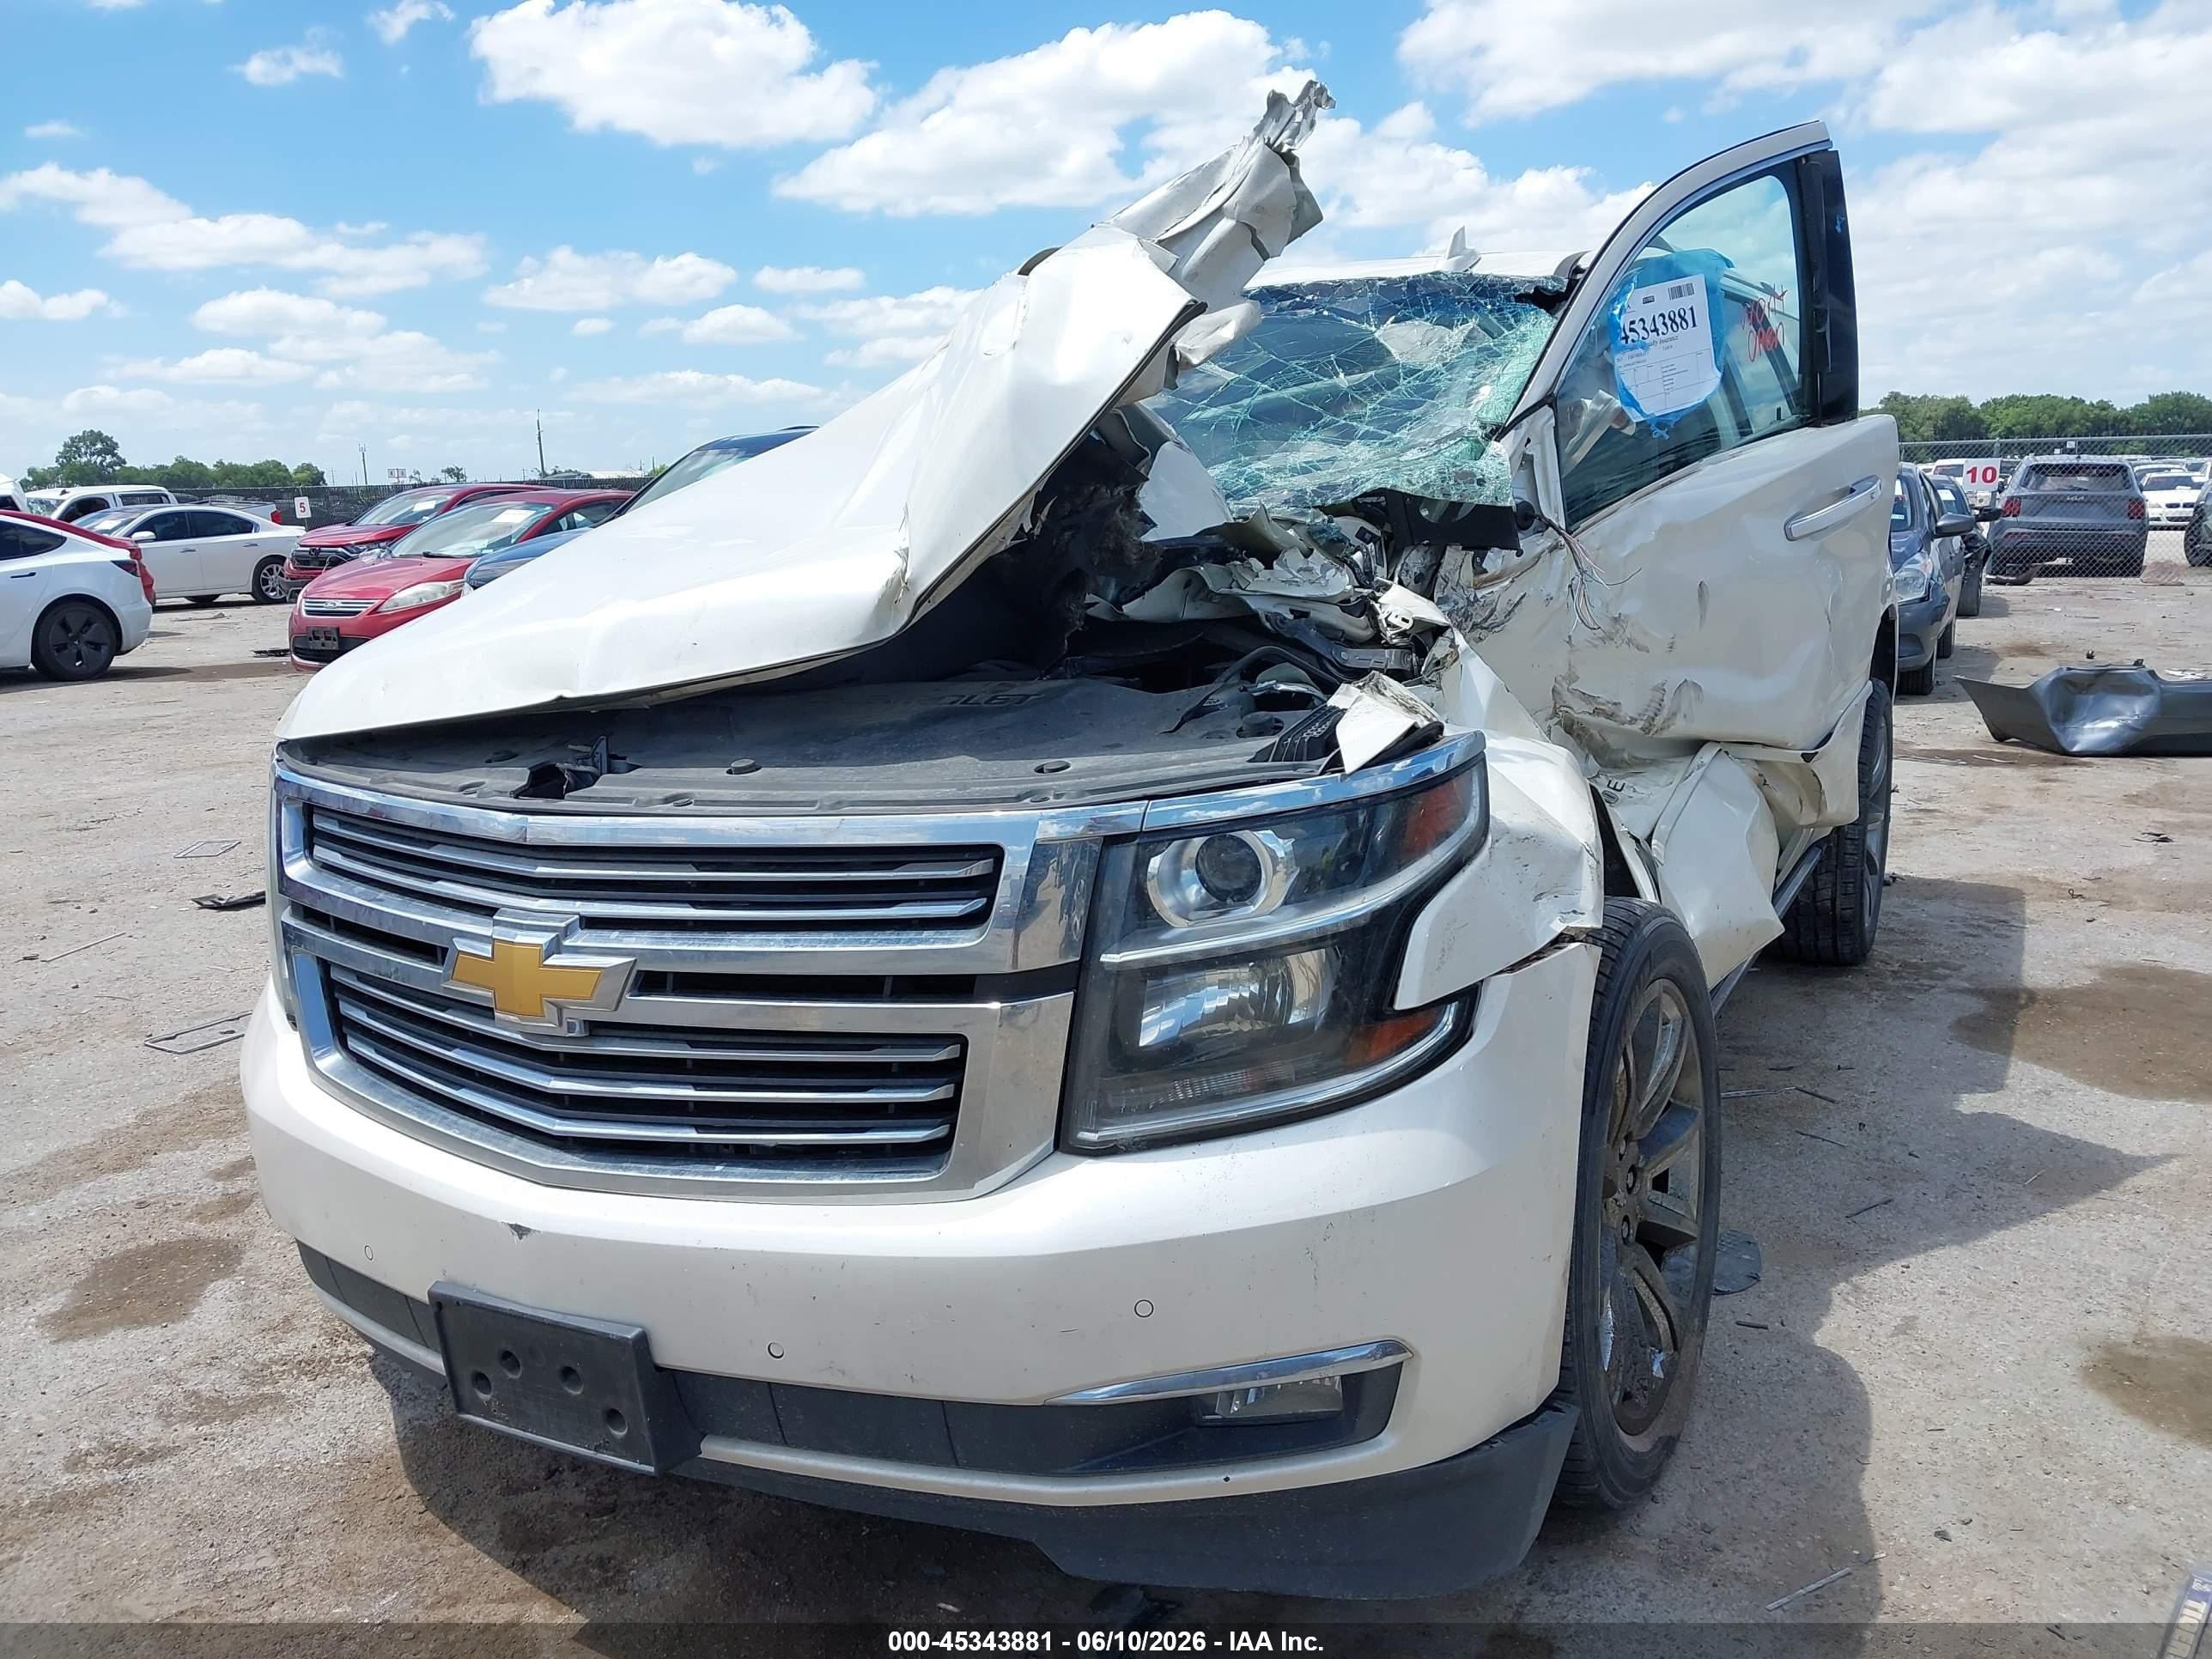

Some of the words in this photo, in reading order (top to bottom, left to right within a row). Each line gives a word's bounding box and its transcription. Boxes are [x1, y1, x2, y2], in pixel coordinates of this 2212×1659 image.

[1620, 305, 1698, 344] 45343881
[1966, 466, 1997, 483] 10
[299, 501, 307, 513] 5
